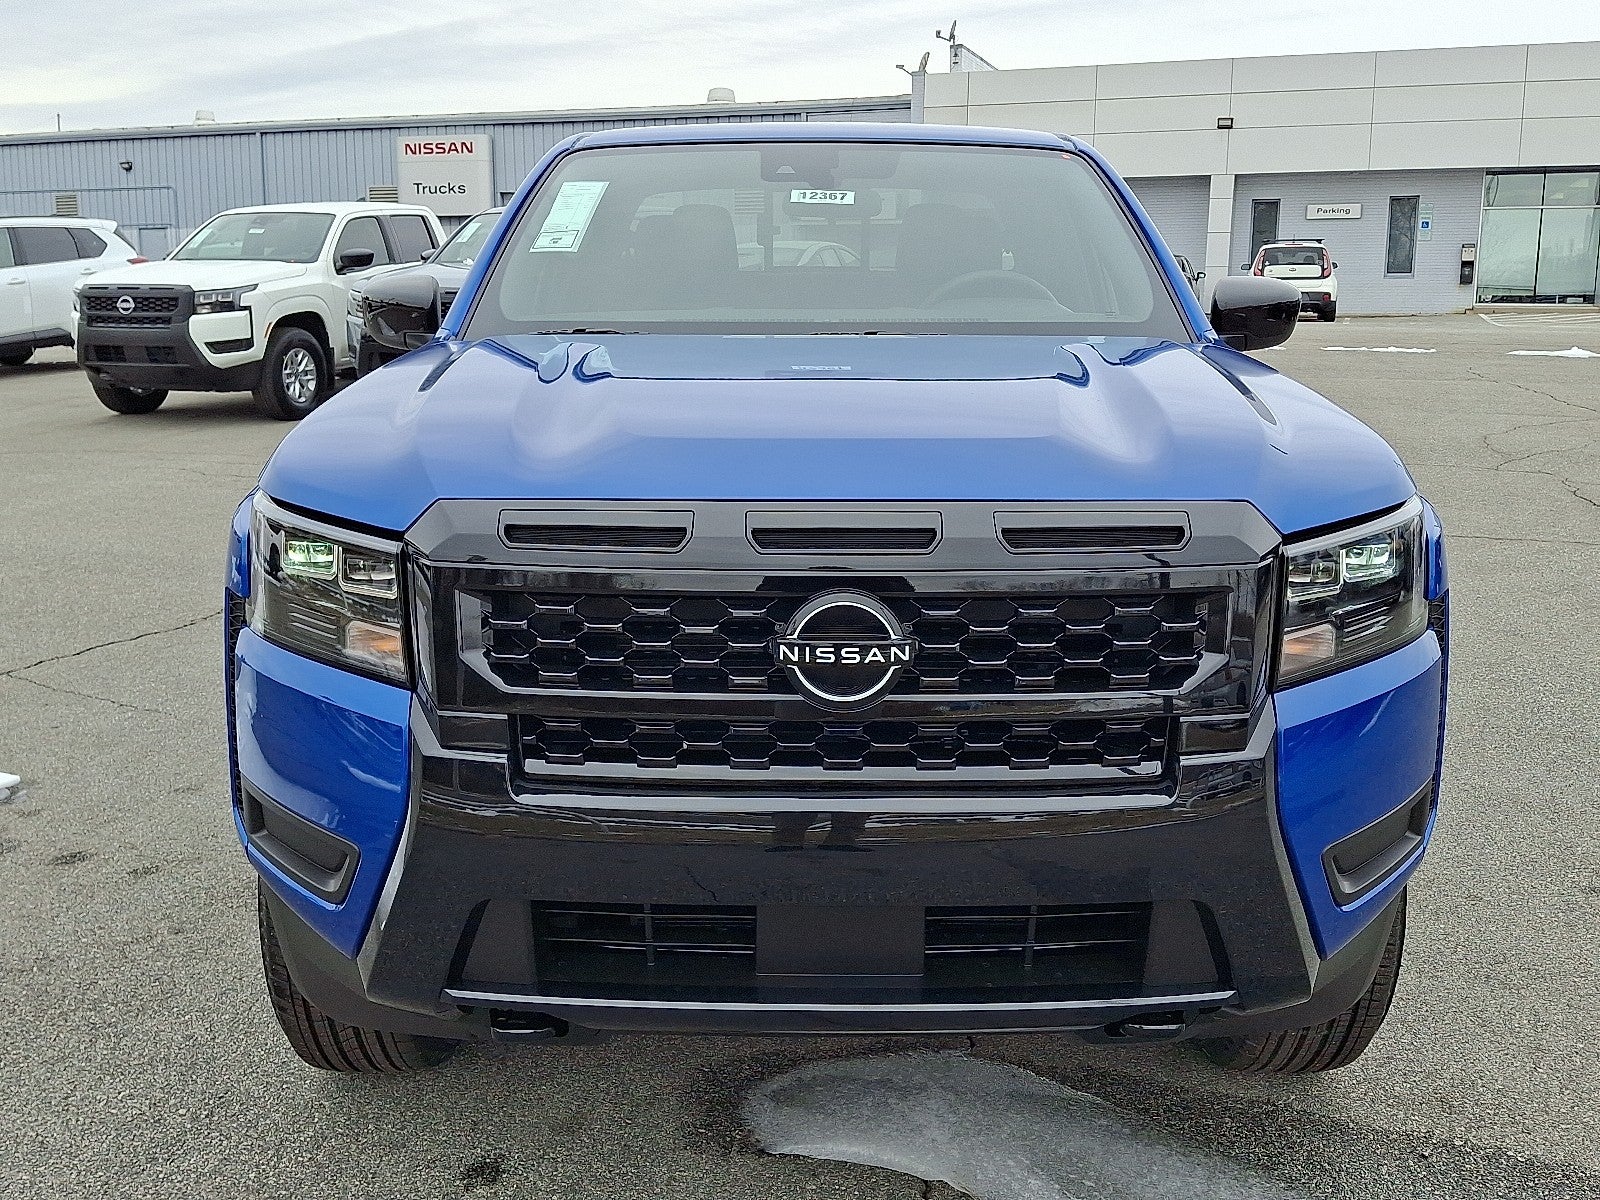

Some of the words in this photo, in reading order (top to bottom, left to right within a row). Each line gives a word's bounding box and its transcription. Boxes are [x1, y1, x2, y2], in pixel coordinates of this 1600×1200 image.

[404, 141, 474, 156] NISSAN
[412, 181, 467, 195] Trucks
[799, 191, 848, 201] 12367
[1316, 207, 1351, 215] Parking
[779, 644, 910, 664] NISSAN
